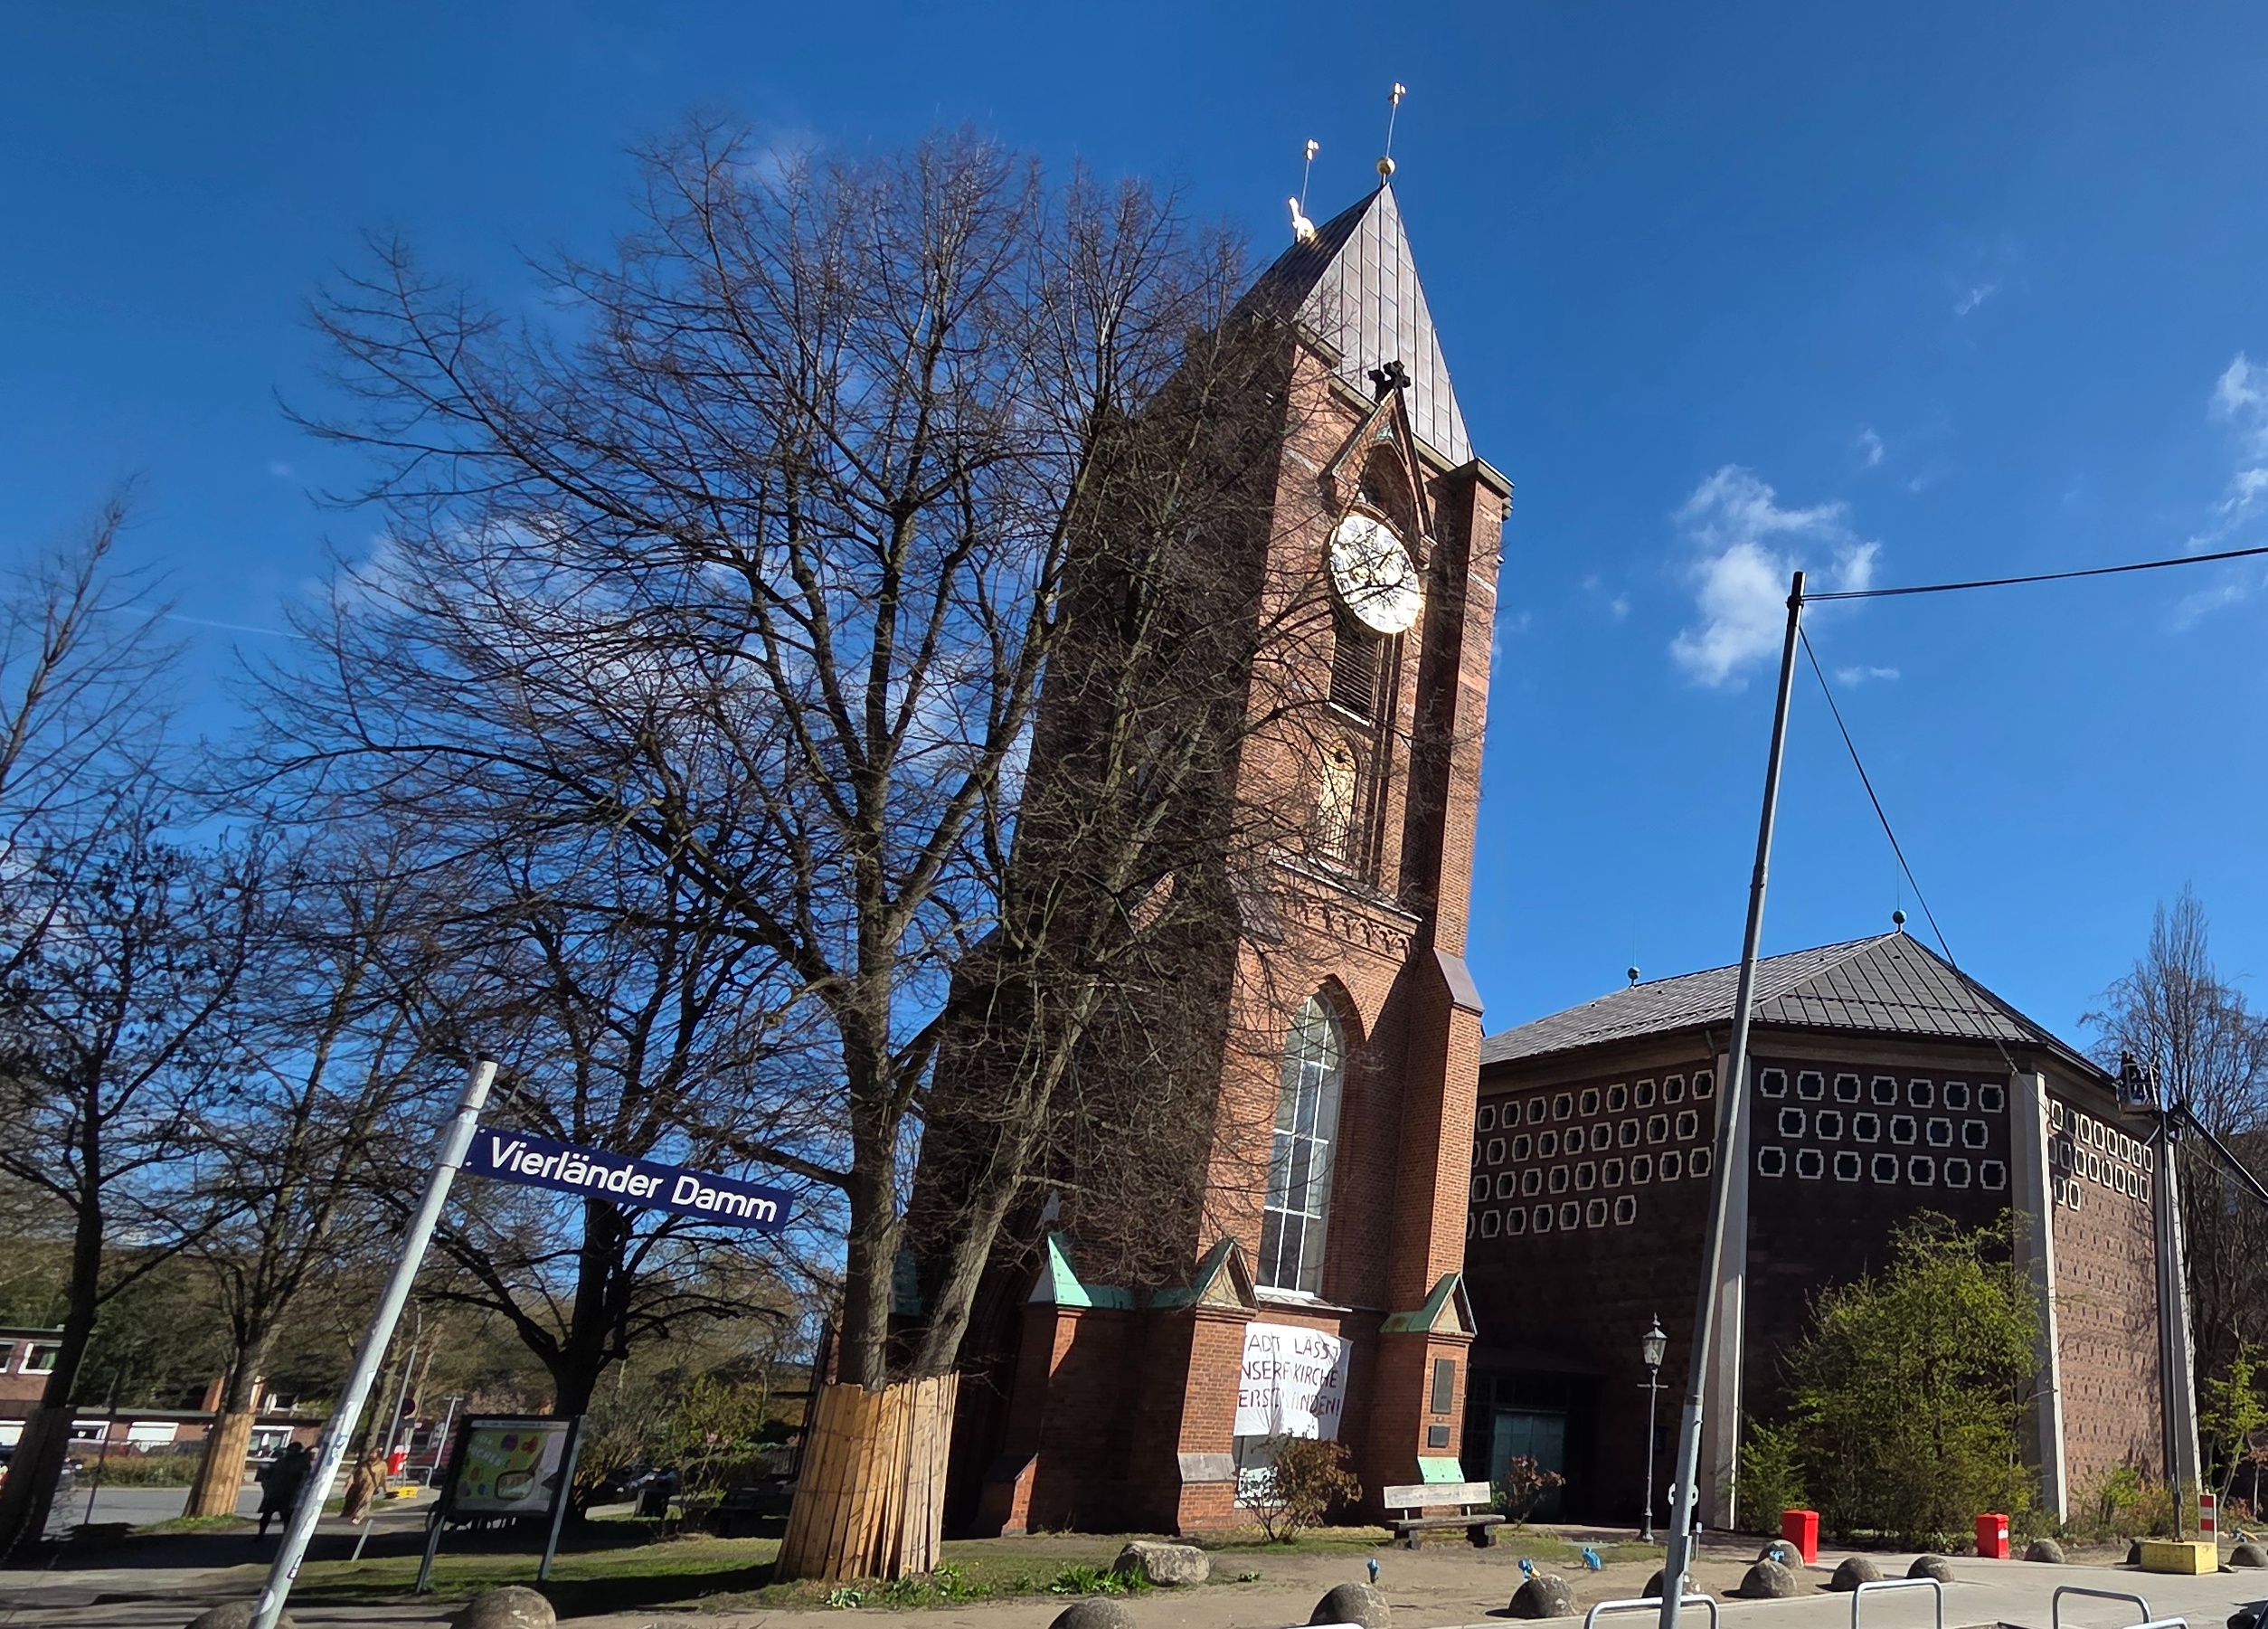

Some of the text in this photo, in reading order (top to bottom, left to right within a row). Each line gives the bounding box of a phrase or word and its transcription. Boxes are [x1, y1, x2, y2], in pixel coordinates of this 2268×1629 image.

[491, 1136, 777, 1222] Vierländer Damm
[1245, 1334, 1281, 1352] ADT
[1241, 1360, 1338, 1388] NSERE KIRCHE
